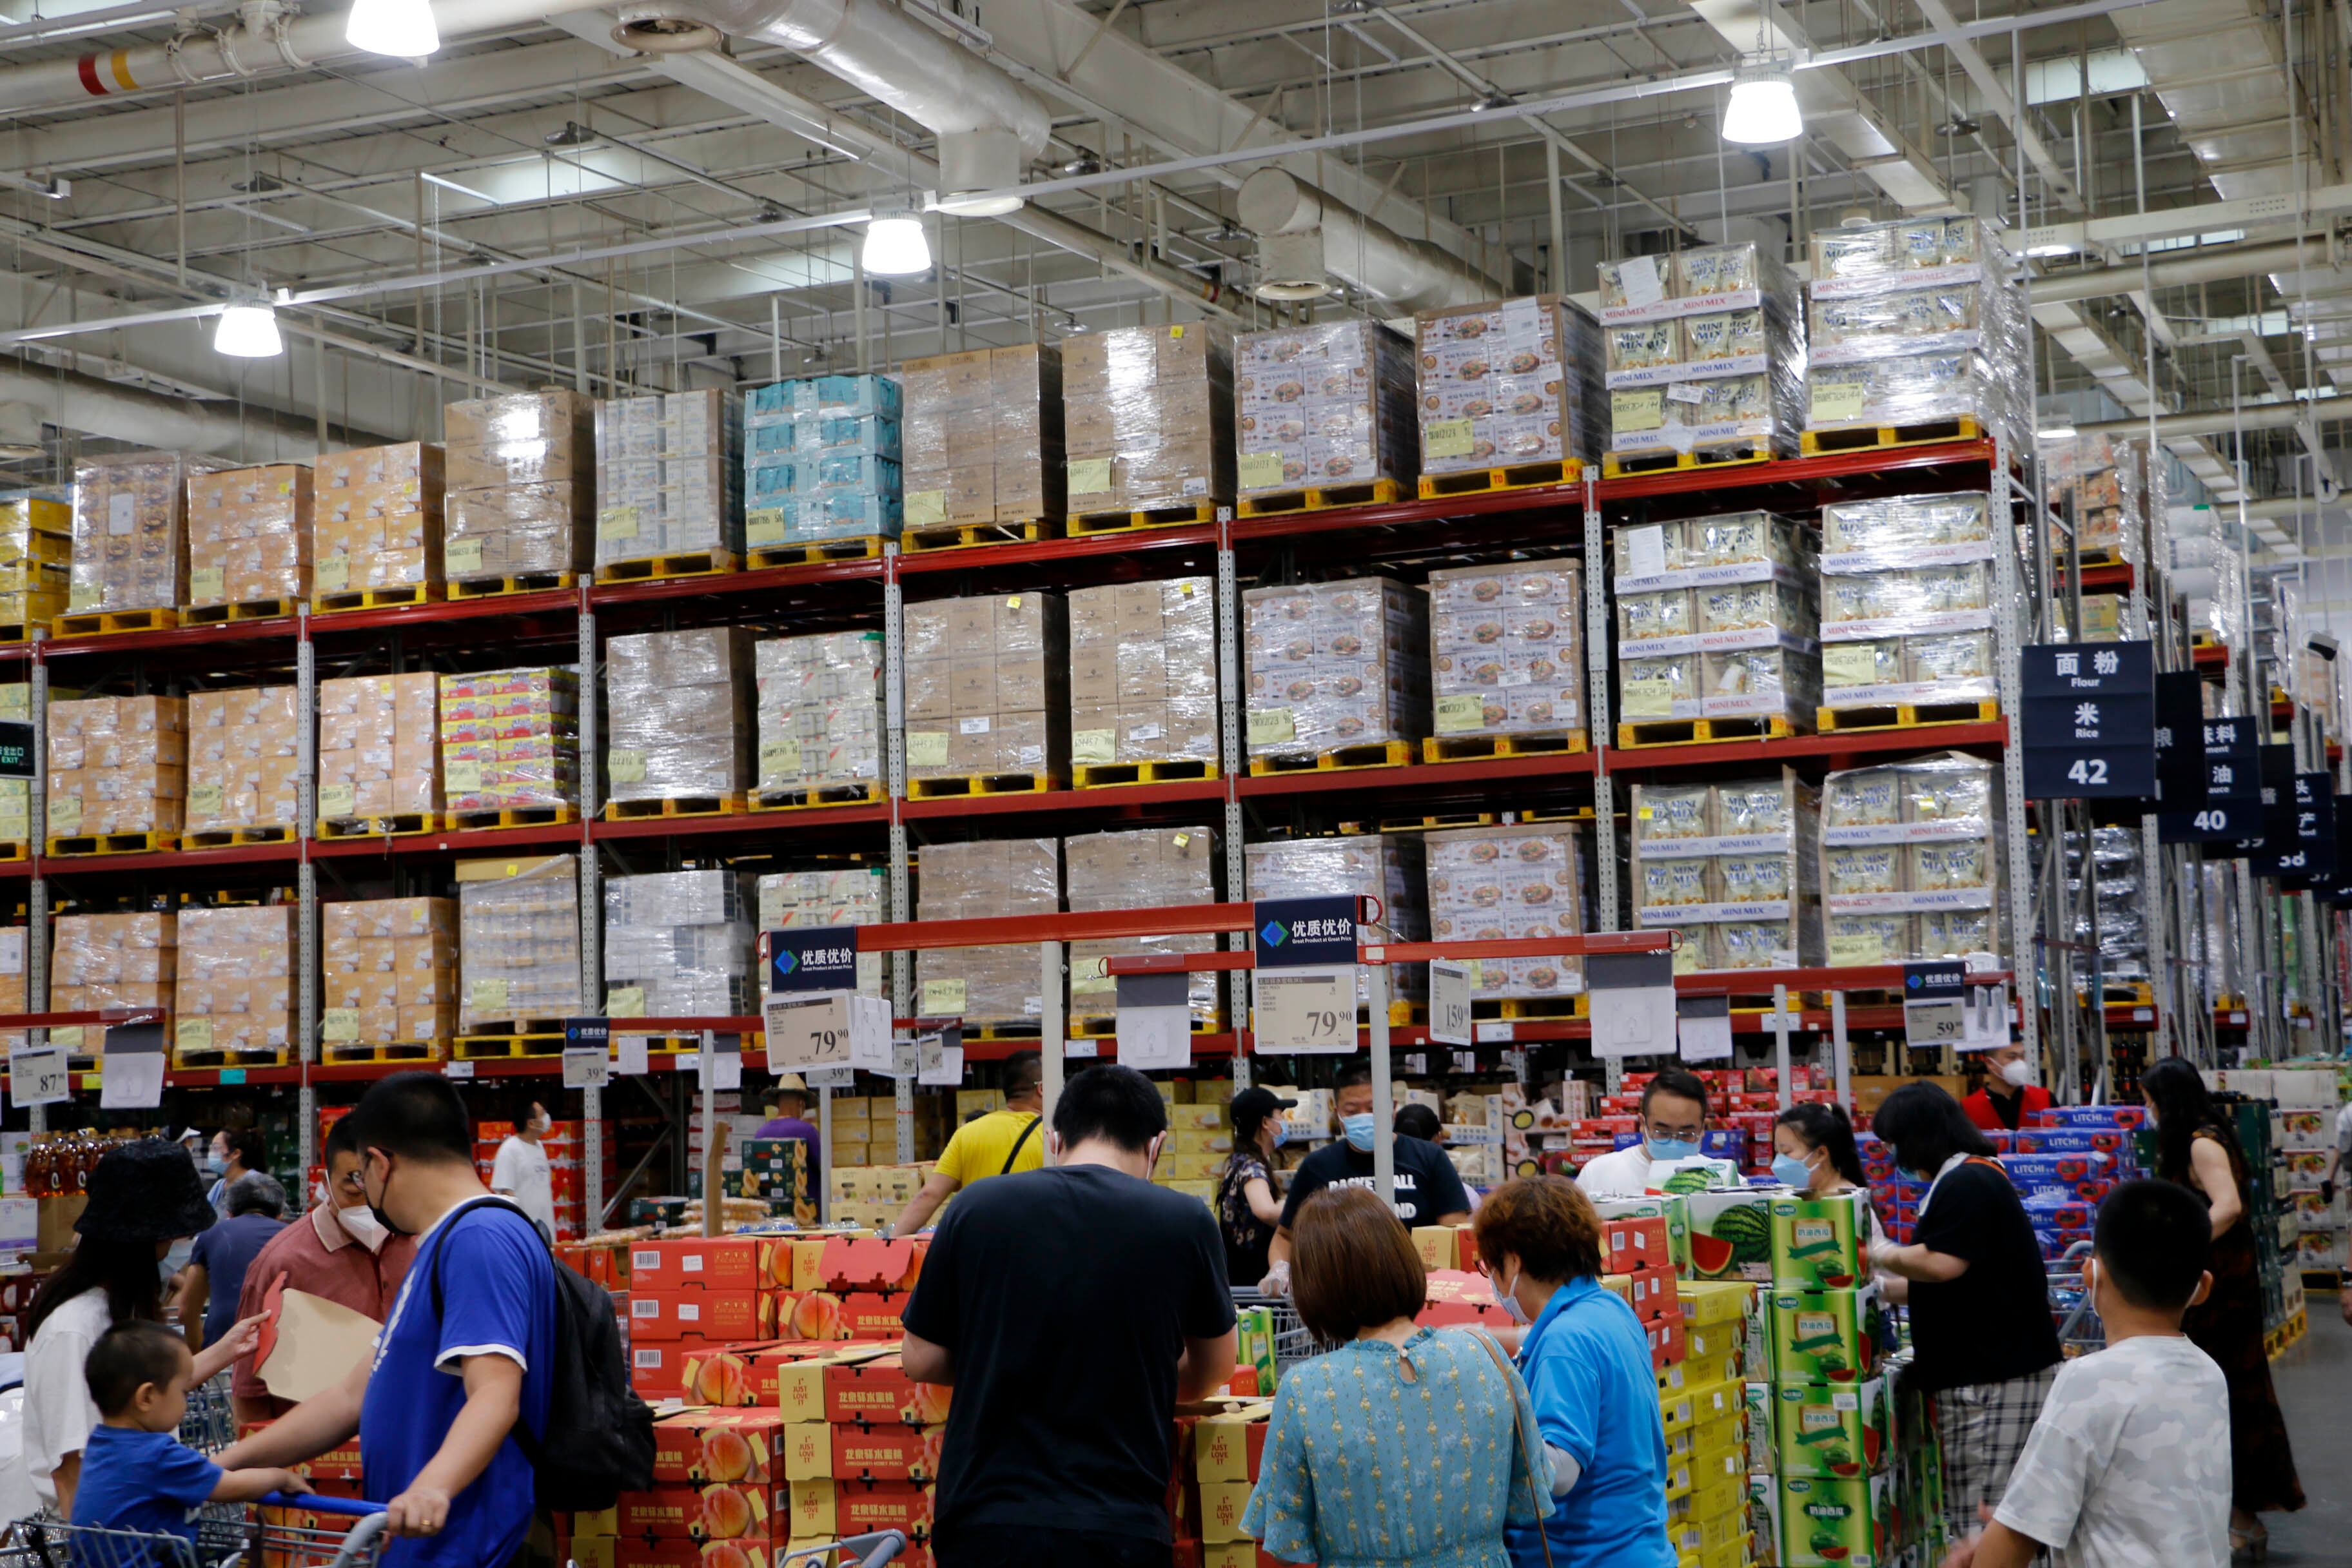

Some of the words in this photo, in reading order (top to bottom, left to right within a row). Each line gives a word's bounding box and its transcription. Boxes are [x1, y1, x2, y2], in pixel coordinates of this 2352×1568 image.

[1683, 301, 1704, 309] MINI
[1625, 308, 1646, 316] MIX
[1696, 322, 1722, 331] MINI
[1698, 331, 1722, 340] MIX
[1620, 342, 1644, 350] MIX
[1713, 362, 1734, 371] MIX
[1633, 372, 1653, 381] MIX
[1698, 572, 1718, 580] MINI
[2055, 651, 2119, 676] 面粉
[2071, 678, 2099, 687] Flour
[2075, 702, 2099, 725] 米
[2075, 729, 2099, 738] Rice
[2068, 759, 2108, 784] 42
[2213, 765, 2233, 783] 油
[2295, 779, 2308, 794] 头
[2194, 810, 2226, 830] 40
[2299, 812, 2315, 828] 产
[1948, 859, 1974, 868] MIX
[1755, 871, 1780, 879] MIX
[1292, 918, 1351, 937] 优质优价
[802, 948, 852, 965] 优质优价
[1446, 1003, 1463, 1028] 159
[1937, 1022, 1954, 1035] 59
[586, 1068, 599, 1079] 39
[40, 1074, 57, 1092] 87
[2014, 1165, 2044, 1173] LITCHI
[1393, 1202, 1416, 1219] ND
[857, 1315, 903, 1325] 龙泉驿水蜜
[839, 1391, 894, 1402] 龙泉驿水蜜桃
[845, 1449, 903, 1460] 龙泉驿水蜜桃
[851, 1504, 906, 1515] 龙泉驿水蜜桃
